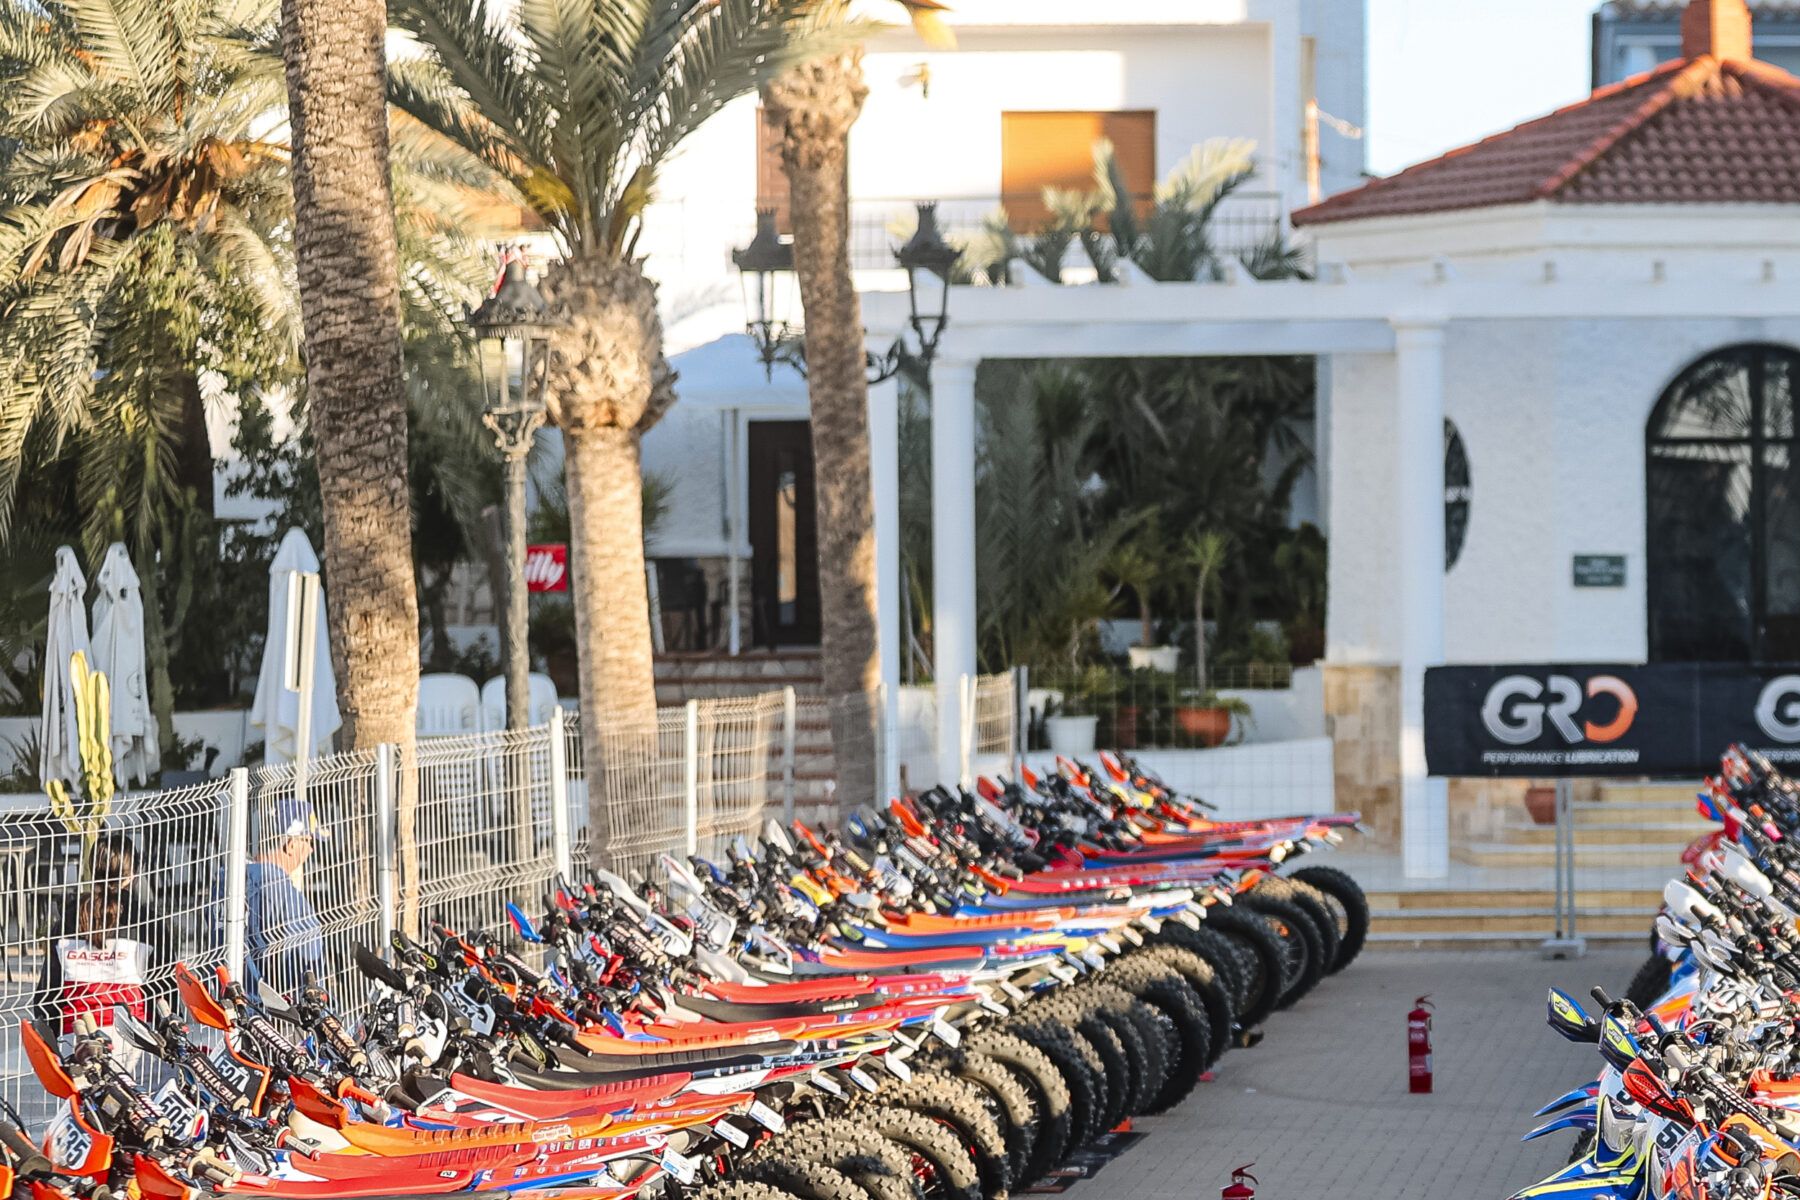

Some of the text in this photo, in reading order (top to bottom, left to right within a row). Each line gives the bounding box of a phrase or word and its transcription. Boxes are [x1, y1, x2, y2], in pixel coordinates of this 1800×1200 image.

[1482, 674, 1639, 744] GRO
[1484, 748, 1640, 765] PERFORMANCE LUBRICATION
[253, 1019, 293, 1053] RENTHA
